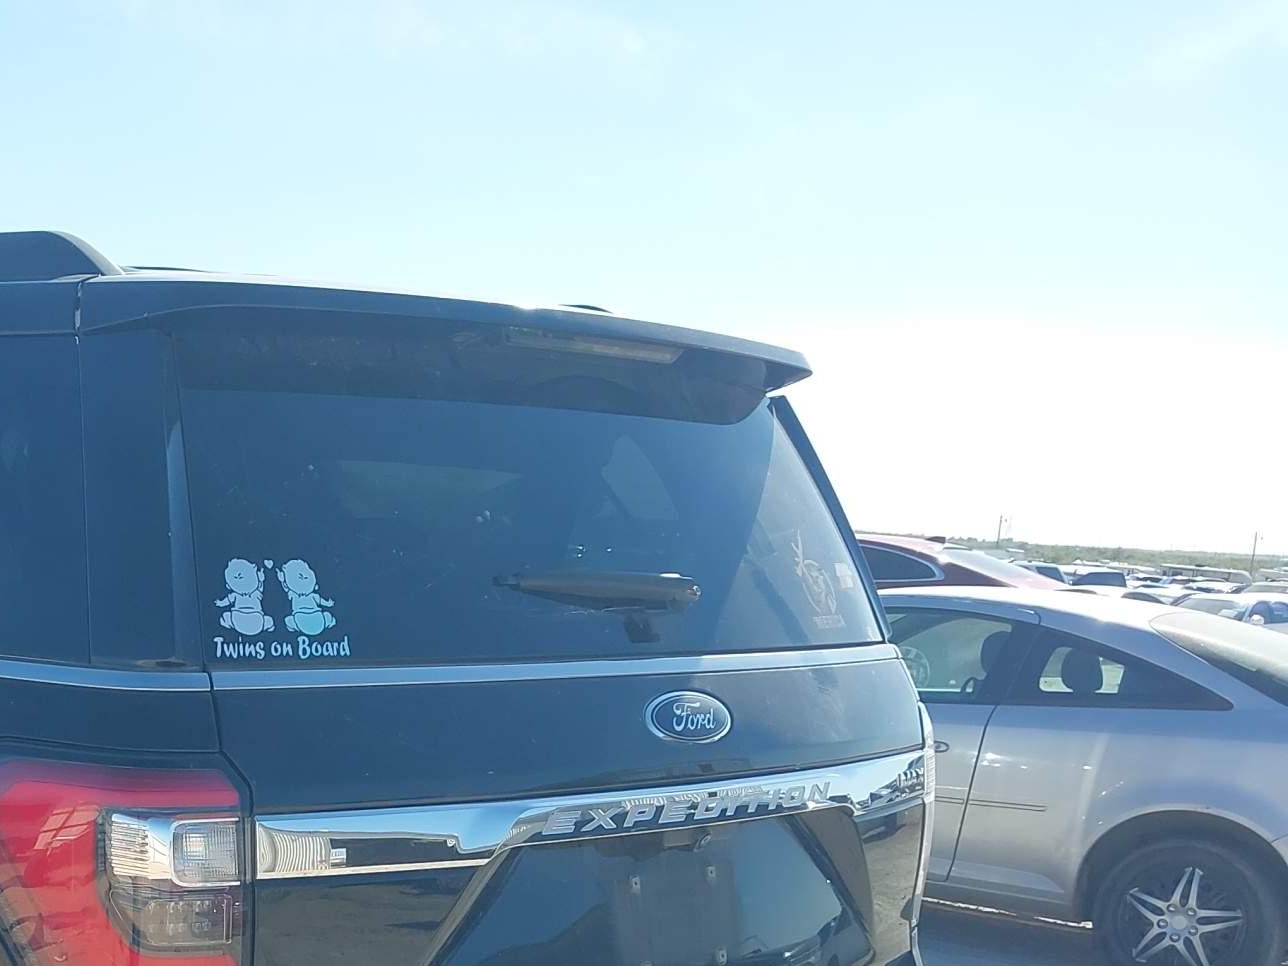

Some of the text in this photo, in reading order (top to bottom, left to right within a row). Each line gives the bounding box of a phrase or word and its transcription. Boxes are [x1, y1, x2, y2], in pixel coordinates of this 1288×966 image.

[213, 635, 351, 660] Twins on Board
[672, 702, 716, 731] Ford
[541, 781, 831, 836] EXPEDITION
